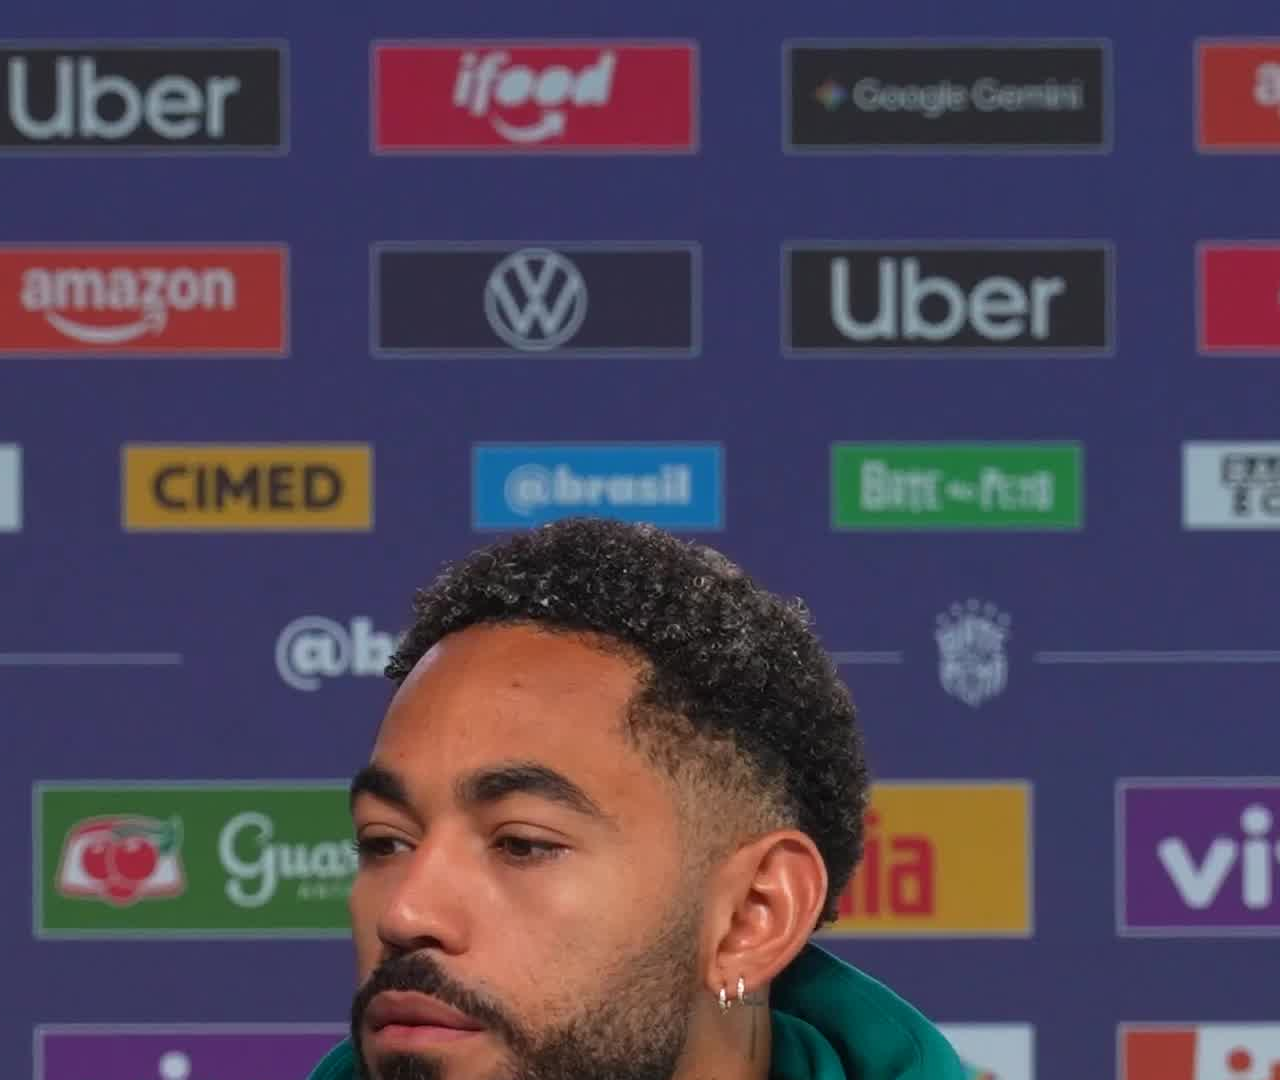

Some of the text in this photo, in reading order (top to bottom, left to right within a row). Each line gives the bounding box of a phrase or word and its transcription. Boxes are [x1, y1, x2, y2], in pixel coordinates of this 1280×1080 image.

[11, 59, 240, 139] Uber
[456, 53, 616, 116] ifood
[854, 79, 1083, 118] Google Gemini
[20, 266, 235, 311] amazon
[833, 260, 1065, 341] Uber
[153, 465, 345, 513] CIMED
